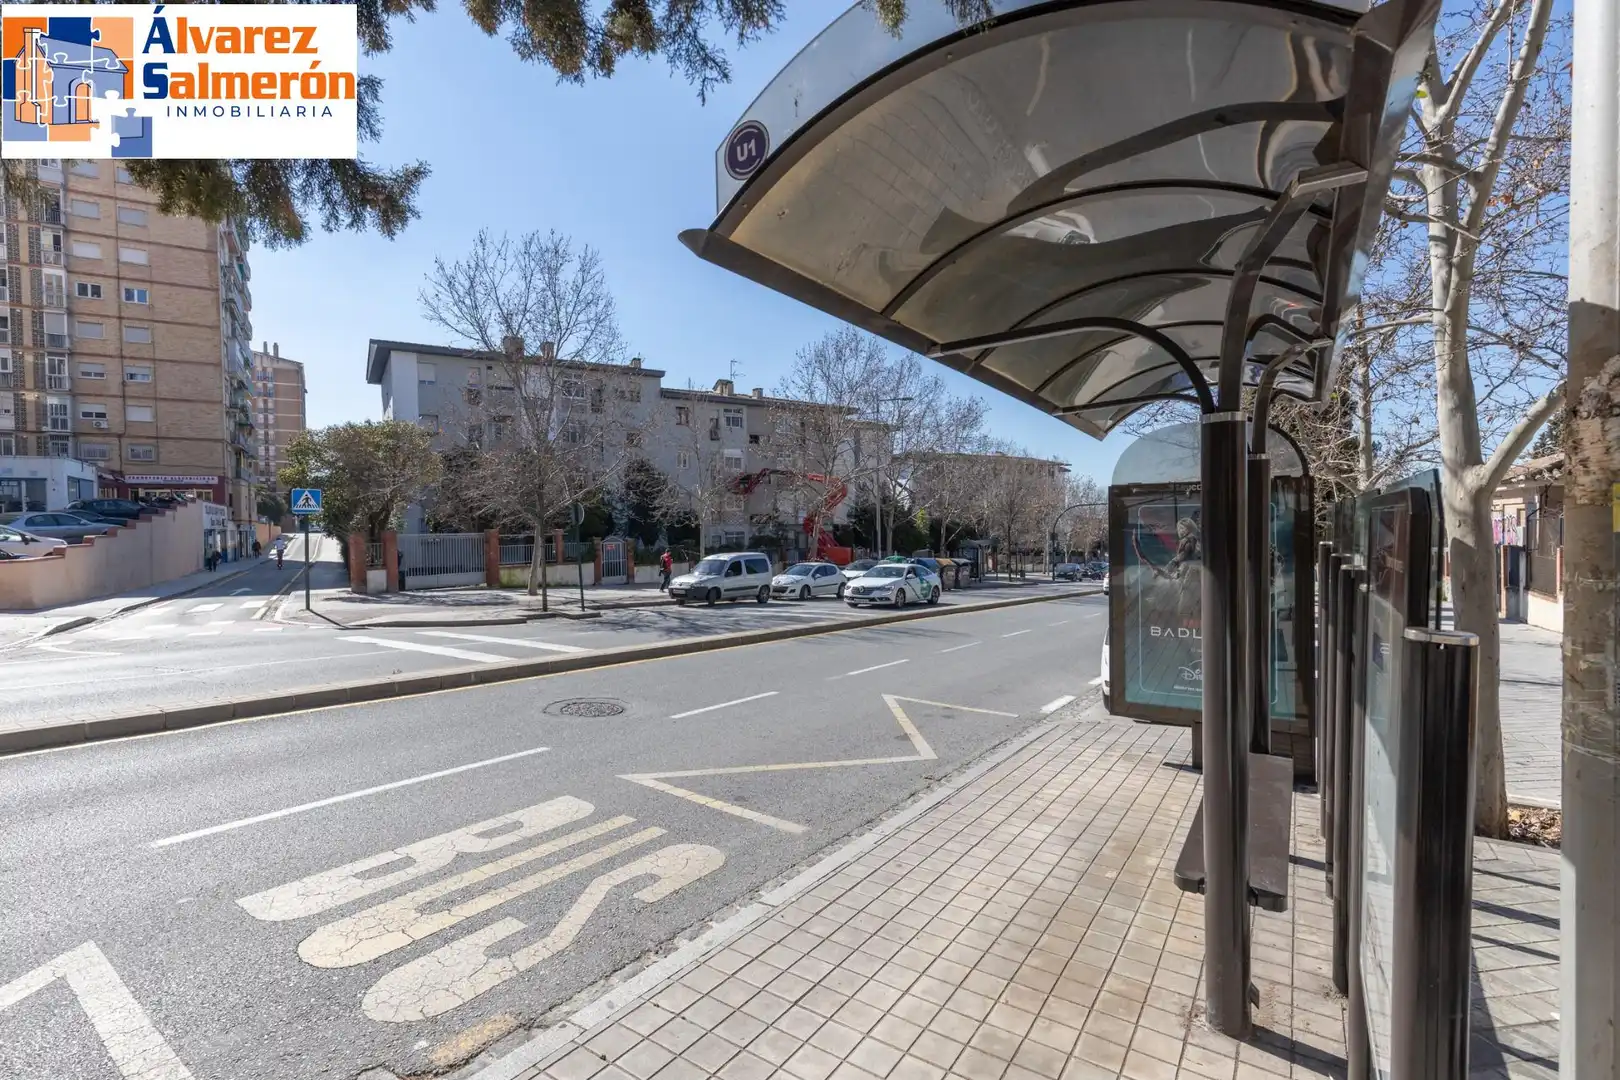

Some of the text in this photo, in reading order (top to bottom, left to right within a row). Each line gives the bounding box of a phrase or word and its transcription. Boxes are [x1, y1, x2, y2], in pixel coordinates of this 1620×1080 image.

[736, 138, 757, 162] U1
[1150, 626, 1203, 639] BADL
[234, 795, 727, 1022] BUS
